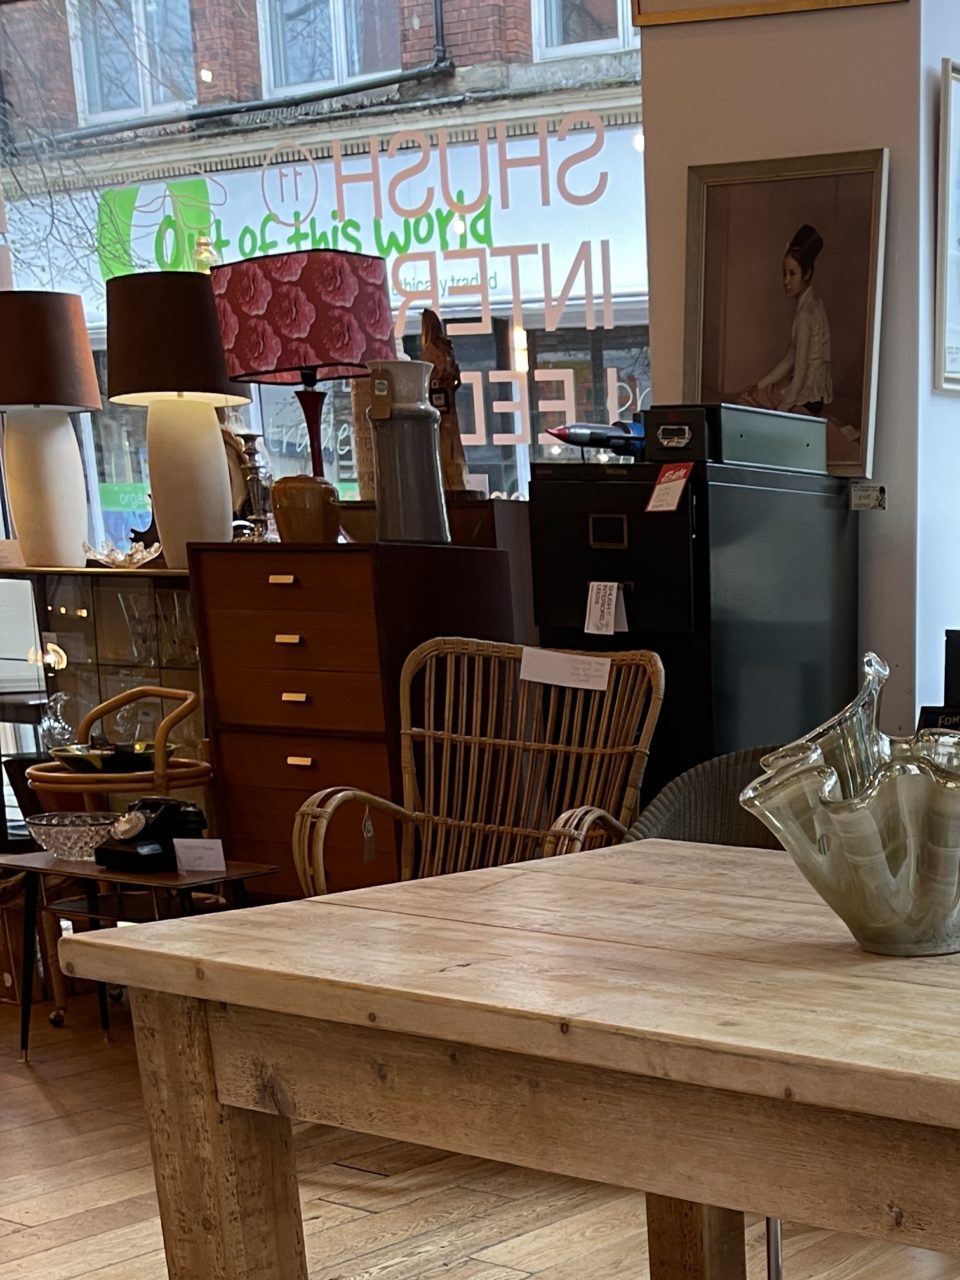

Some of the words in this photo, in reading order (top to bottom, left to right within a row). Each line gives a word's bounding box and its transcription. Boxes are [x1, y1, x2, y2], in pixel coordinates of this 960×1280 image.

[239, 212, 279, 259] of
[287, 210, 362, 254] this
[373, 190, 494, 259] world
[392, 277, 447, 298] ehicay
[450, 271, 497, 290] tradd
[119, 491, 147, 509] orga
